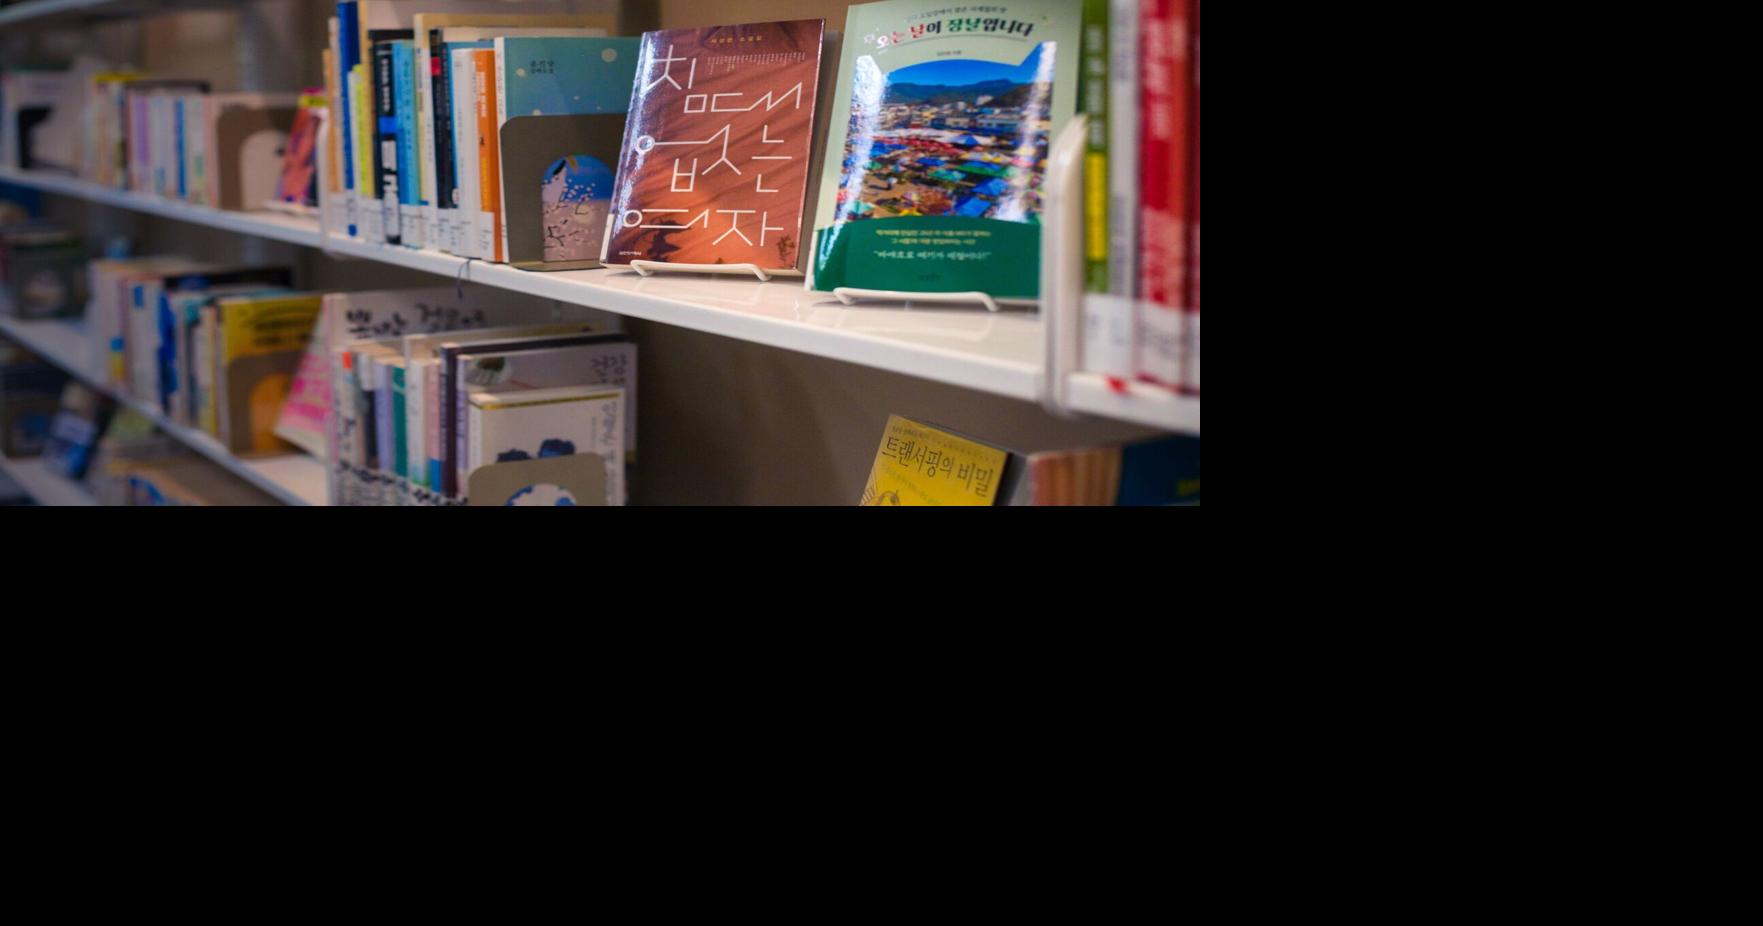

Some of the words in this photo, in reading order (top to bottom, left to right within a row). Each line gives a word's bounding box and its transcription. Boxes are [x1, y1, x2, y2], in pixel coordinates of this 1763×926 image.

[909, 20, 942, 39] 날이
[948, 17, 1035, 37] 장날입니다
[635, 123, 793, 193] 없는
[622, 208, 785, 247] 여자
[882, 436, 956, 479] 트랜서핑의
[957, 462, 994, 498] 비밀
